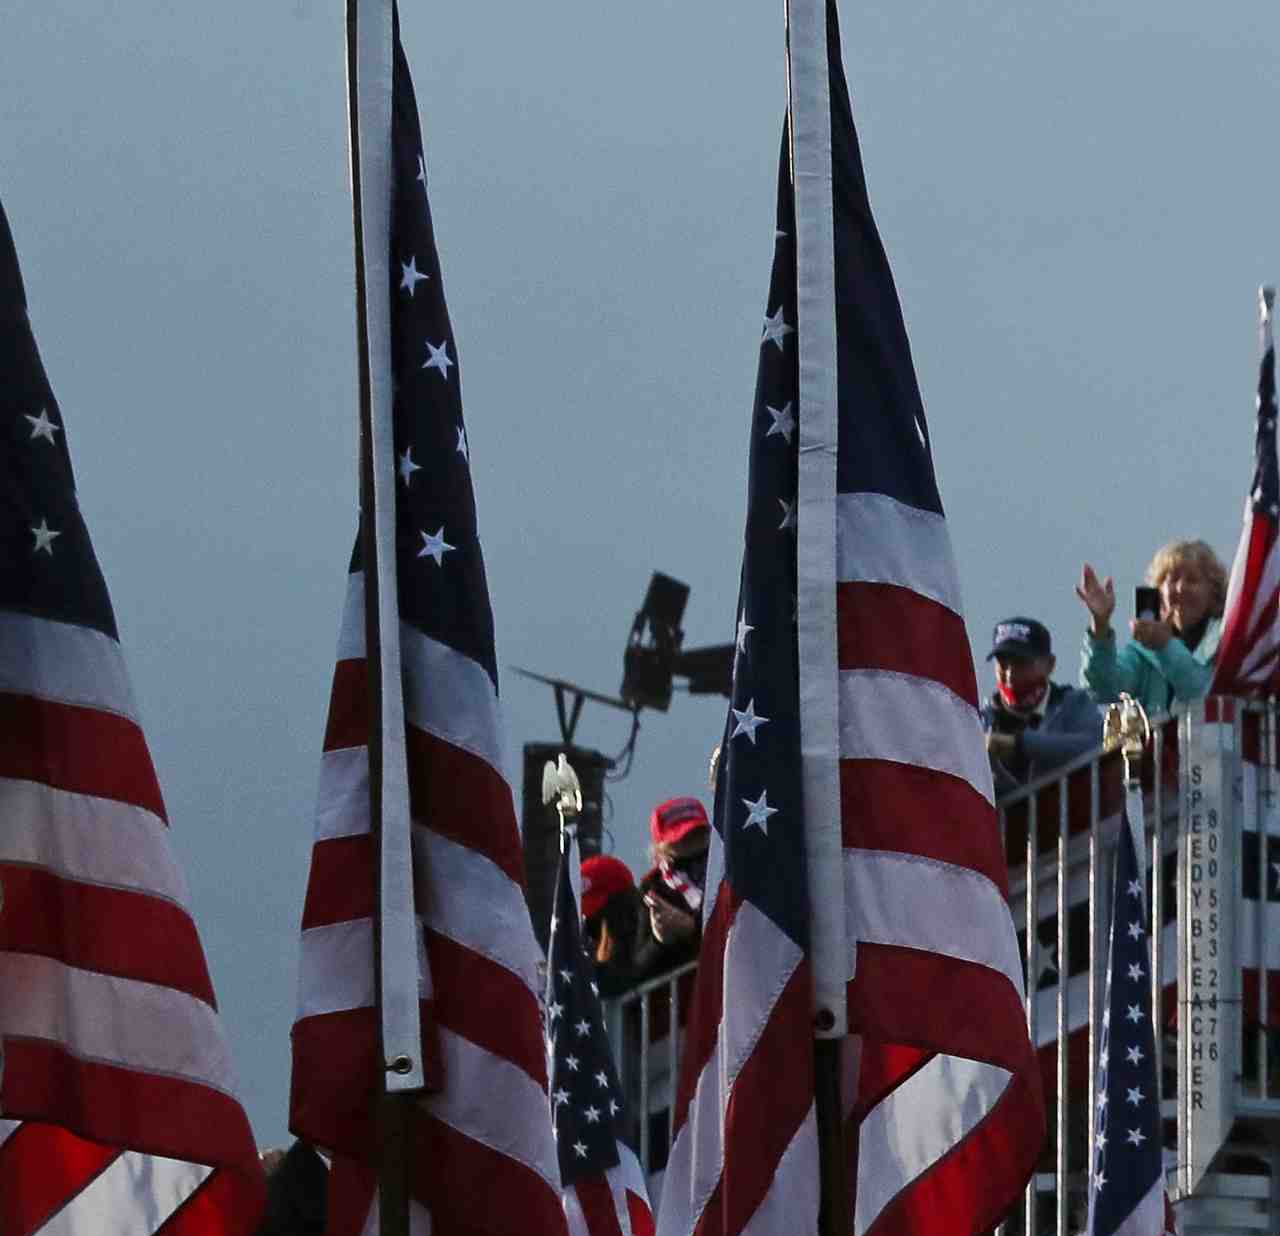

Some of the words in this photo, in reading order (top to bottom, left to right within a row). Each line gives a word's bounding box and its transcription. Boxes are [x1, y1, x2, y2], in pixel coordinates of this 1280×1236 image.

[1191, 765, 1203, 908] SPEEDY
[1207, 807, 1218, 879] 800
[1207, 887, 1218, 957] 553
[1191, 918, 1203, 1110] BLEACHER
[1207, 967, 1219, 1062] 2476
